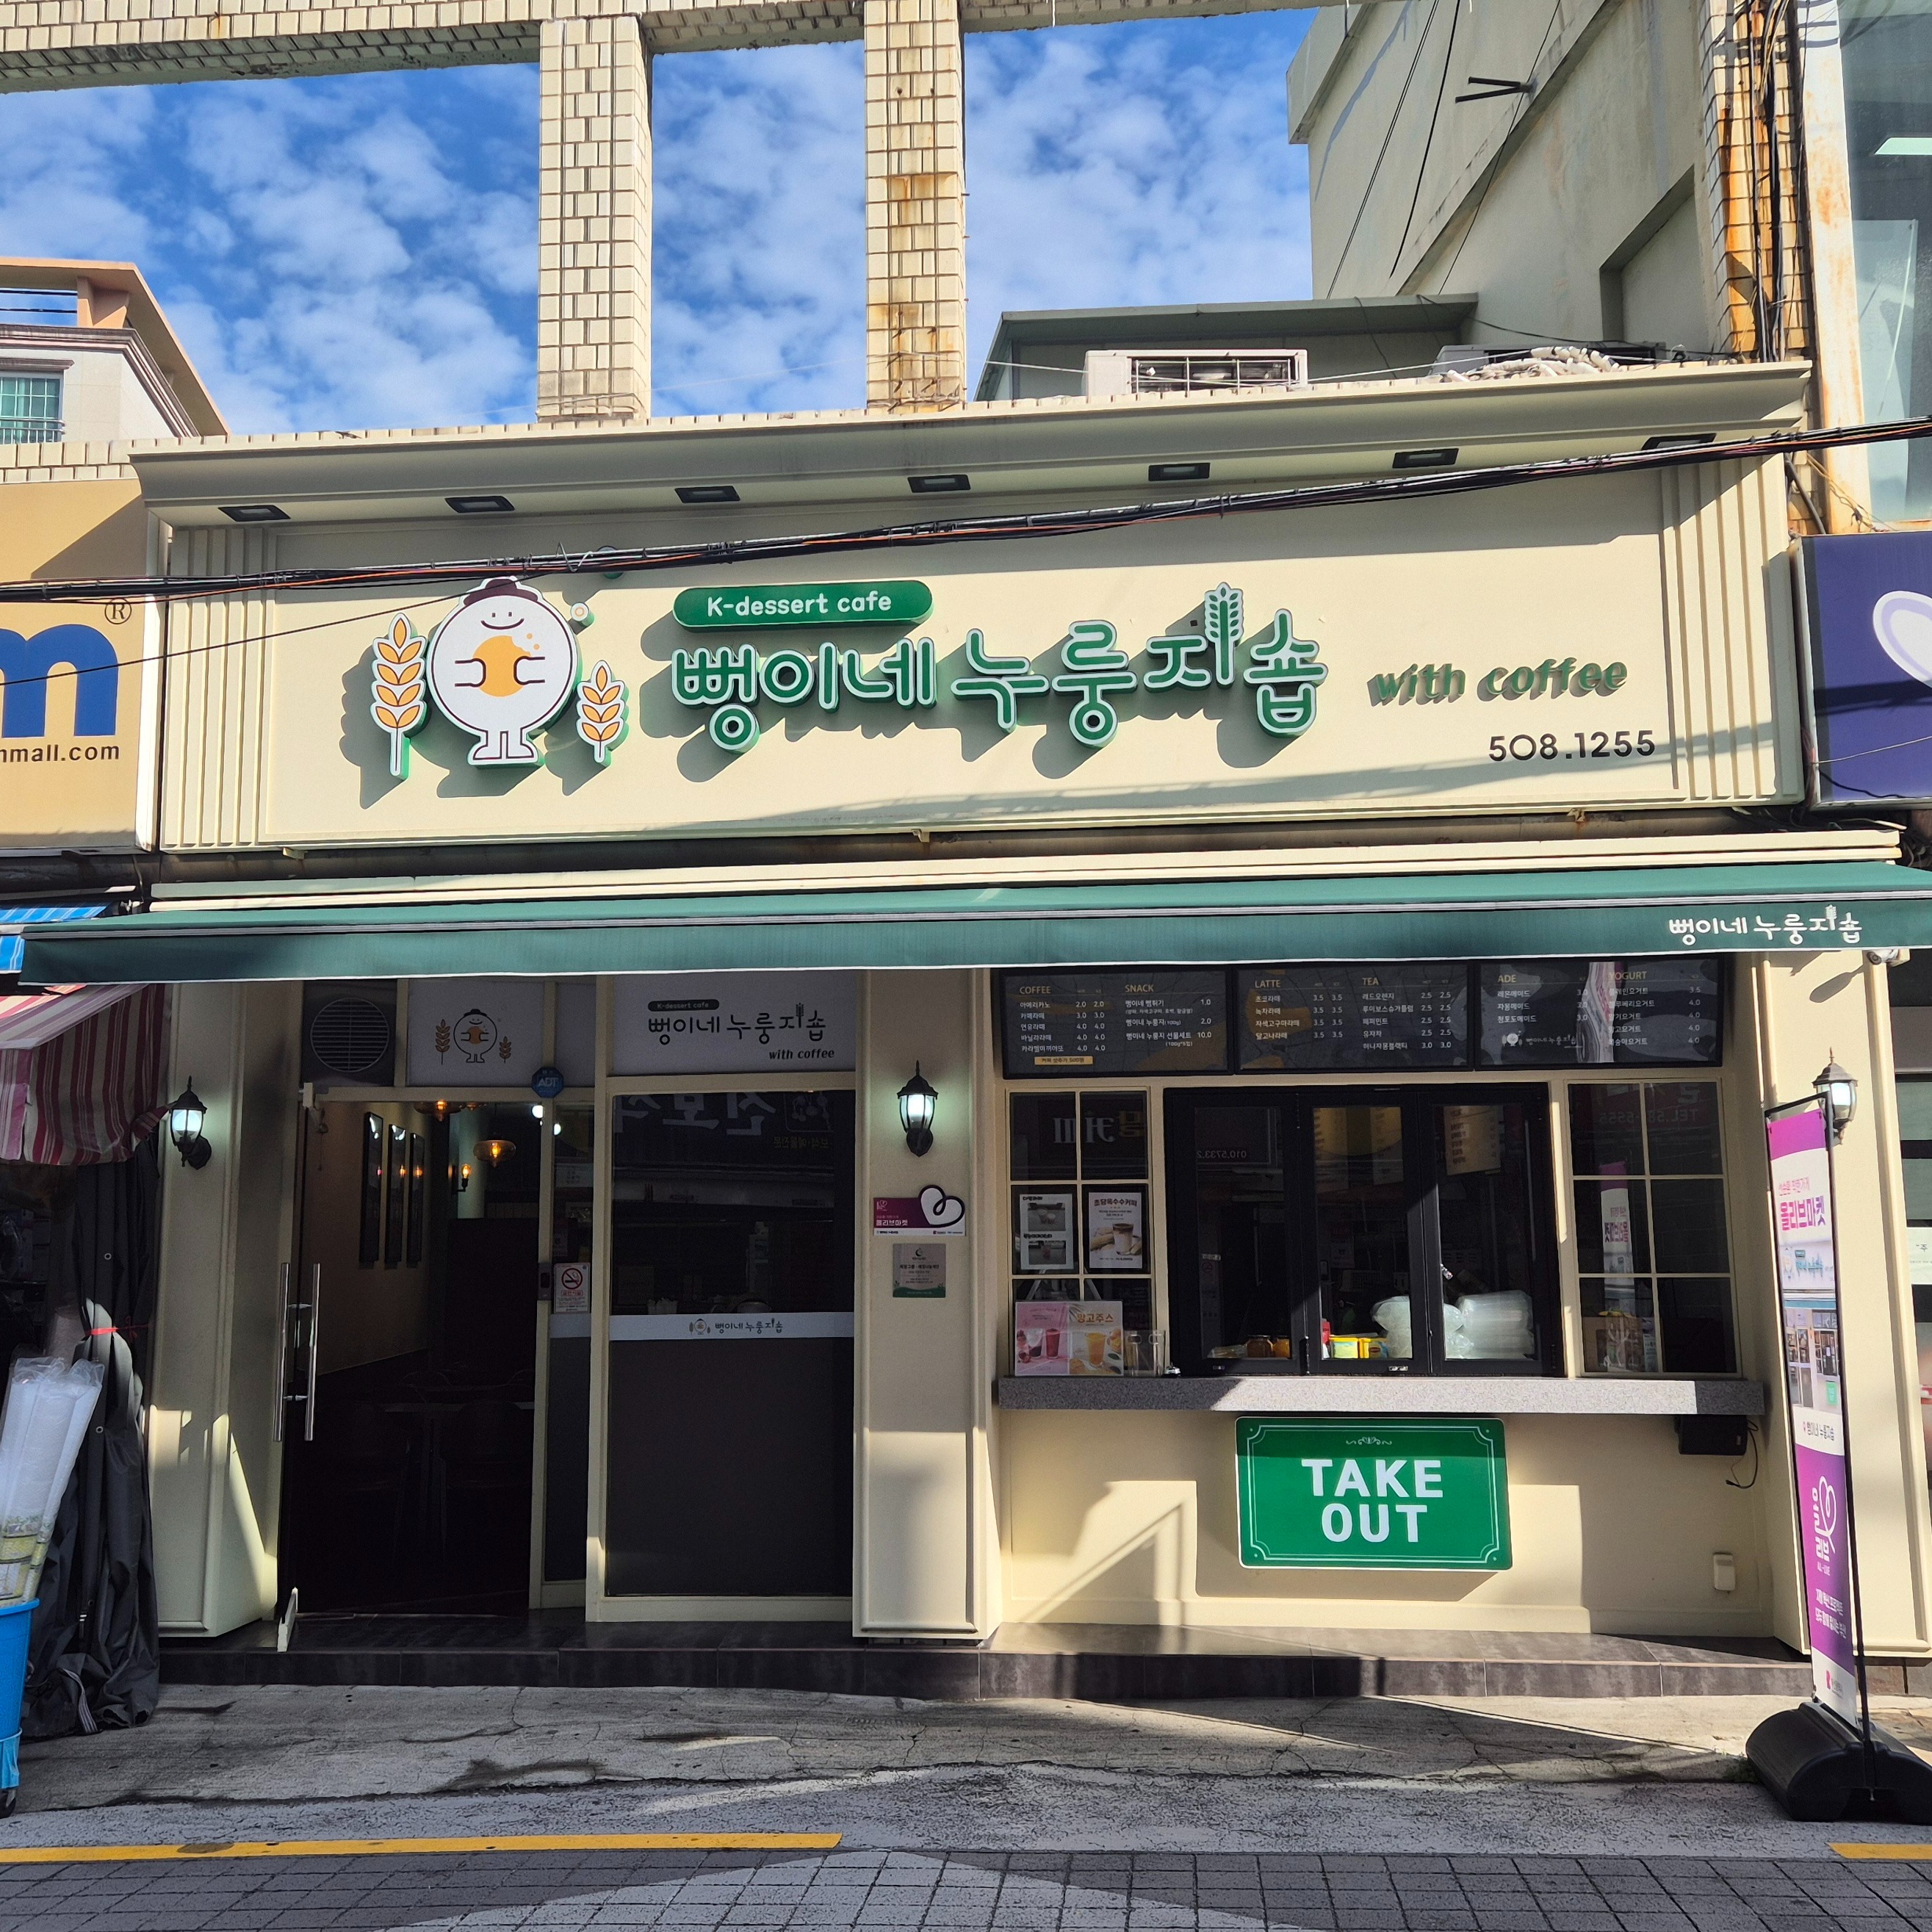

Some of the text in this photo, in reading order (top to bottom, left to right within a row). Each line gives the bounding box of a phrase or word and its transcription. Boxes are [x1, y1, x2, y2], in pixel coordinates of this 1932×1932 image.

[706, 590, 893, 619] K-dessert cafe
[671, 582, 1329, 754] 뻥이네 누룽지숍
[1376, 657, 1628, 702] with coffee
[1488, 730, 1656, 762] 508.1255
[1668, 904, 1862, 946] 뻥이네 누룽지숍
[1497, 974, 1517, 983] ADE
[1609, 970, 1648, 980] YOGURT
[1255, 979, 1282, 988] LATTE
[1362, 977, 1380, 986] TEA
[1019, 986, 1051, 994] COFFEE
[1125, 984, 1154, 992] SNACK
[1255, 995, 1280, 1003] 초코라떼
[657, 1001, 691, 1009] K-dessert
[1255, 1007, 1281, 1015] 녹차라떼
[649, 1003, 826, 1045] 뻥이네 누룽지숍
[1125, 1019, 1145, 1027] 뻥이네
[1125, 1032, 1145, 1040] 뻥이네
[1255, 1032, 1288, 1040] 달고나라떼
[769, 1048, 835, 1060] with coffee
[537, 1076, 558, 1088] ADT
[1077, 1313, 1114, 1323] 망고주스
[714, 1322, 743, 1335] 뻥이네
[1301, 1459, 1443, 1498] TAKE
[1322, 1502, 1427, 1543] OUT
